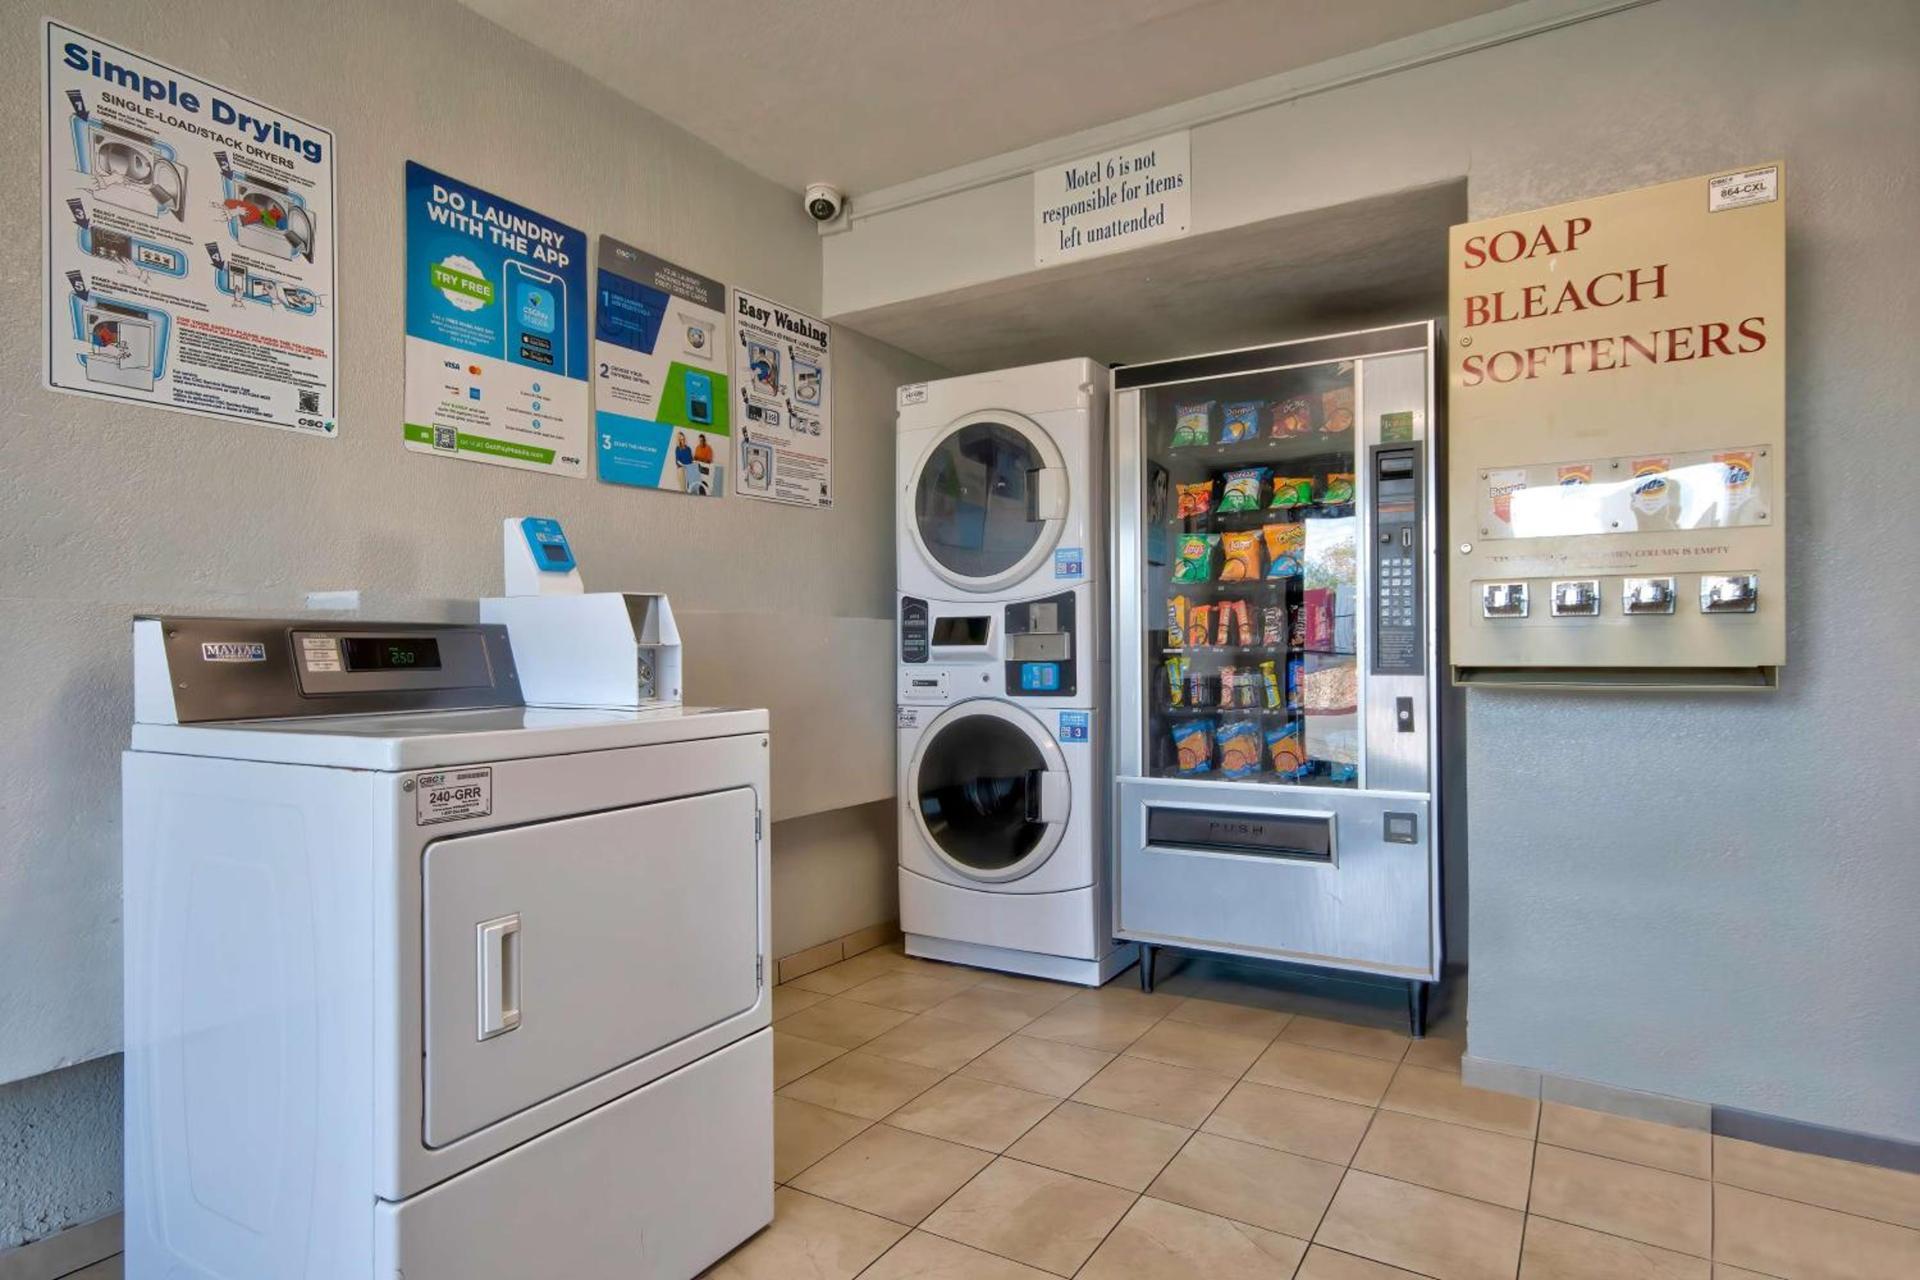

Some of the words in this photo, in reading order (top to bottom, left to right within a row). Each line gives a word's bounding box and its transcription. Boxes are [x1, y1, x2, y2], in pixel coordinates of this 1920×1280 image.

[63, 43, 200, 113] Simple
[212, 98, 322, 164] Drying
[101, 91, 243, 151] SINGLE-LOAD/STACK
[246, 144, 294, 169] DRYERS
[1066, 162, 1101, 192] Motel
[1106, 159, 1115, 179] 6
[1119, 156, 1130, 176] is
[1134, 151, 1156, 172] not
[433, 184, 466, 212] DO
[472, 200, 565, 250] LAUNDRY
[1043, 186, 1118, 225] responsible
[1121, 181, 1141, 202] for
[1145, 174, 1184, 196] items
[427, 202, 484, 240] WITH
[490, 226, 529, 256] THE
[533, 250, 570, 269] APP
[1060, 227, 1082, 250] left
[1087, 203, 1165, 243] unattended
[1464, 217, 1592, 269] SOAP
[435, 270, 459, 286] TRY
[461, 279, 491, 297] FREE
[602, 291, 609, 306] 1
[1464, 264, 1668, 328] BLEACH
[739, 297, 770, 327] Easy
[774, 310, 827, 347] Washing
[444, 361, 460, 370] VISA
[600, 363, 609, 379] 2
[1462, 317, 1766, 387] SOFTENERS
[298, 418, 324, 429] CSC
[602, 434, 611, 449] 3
[207, 645, 262, 657] MAYTAG
[430, 787, 481, 803] 240-GRR
[1210, 822, 1264, 835] PUSH
